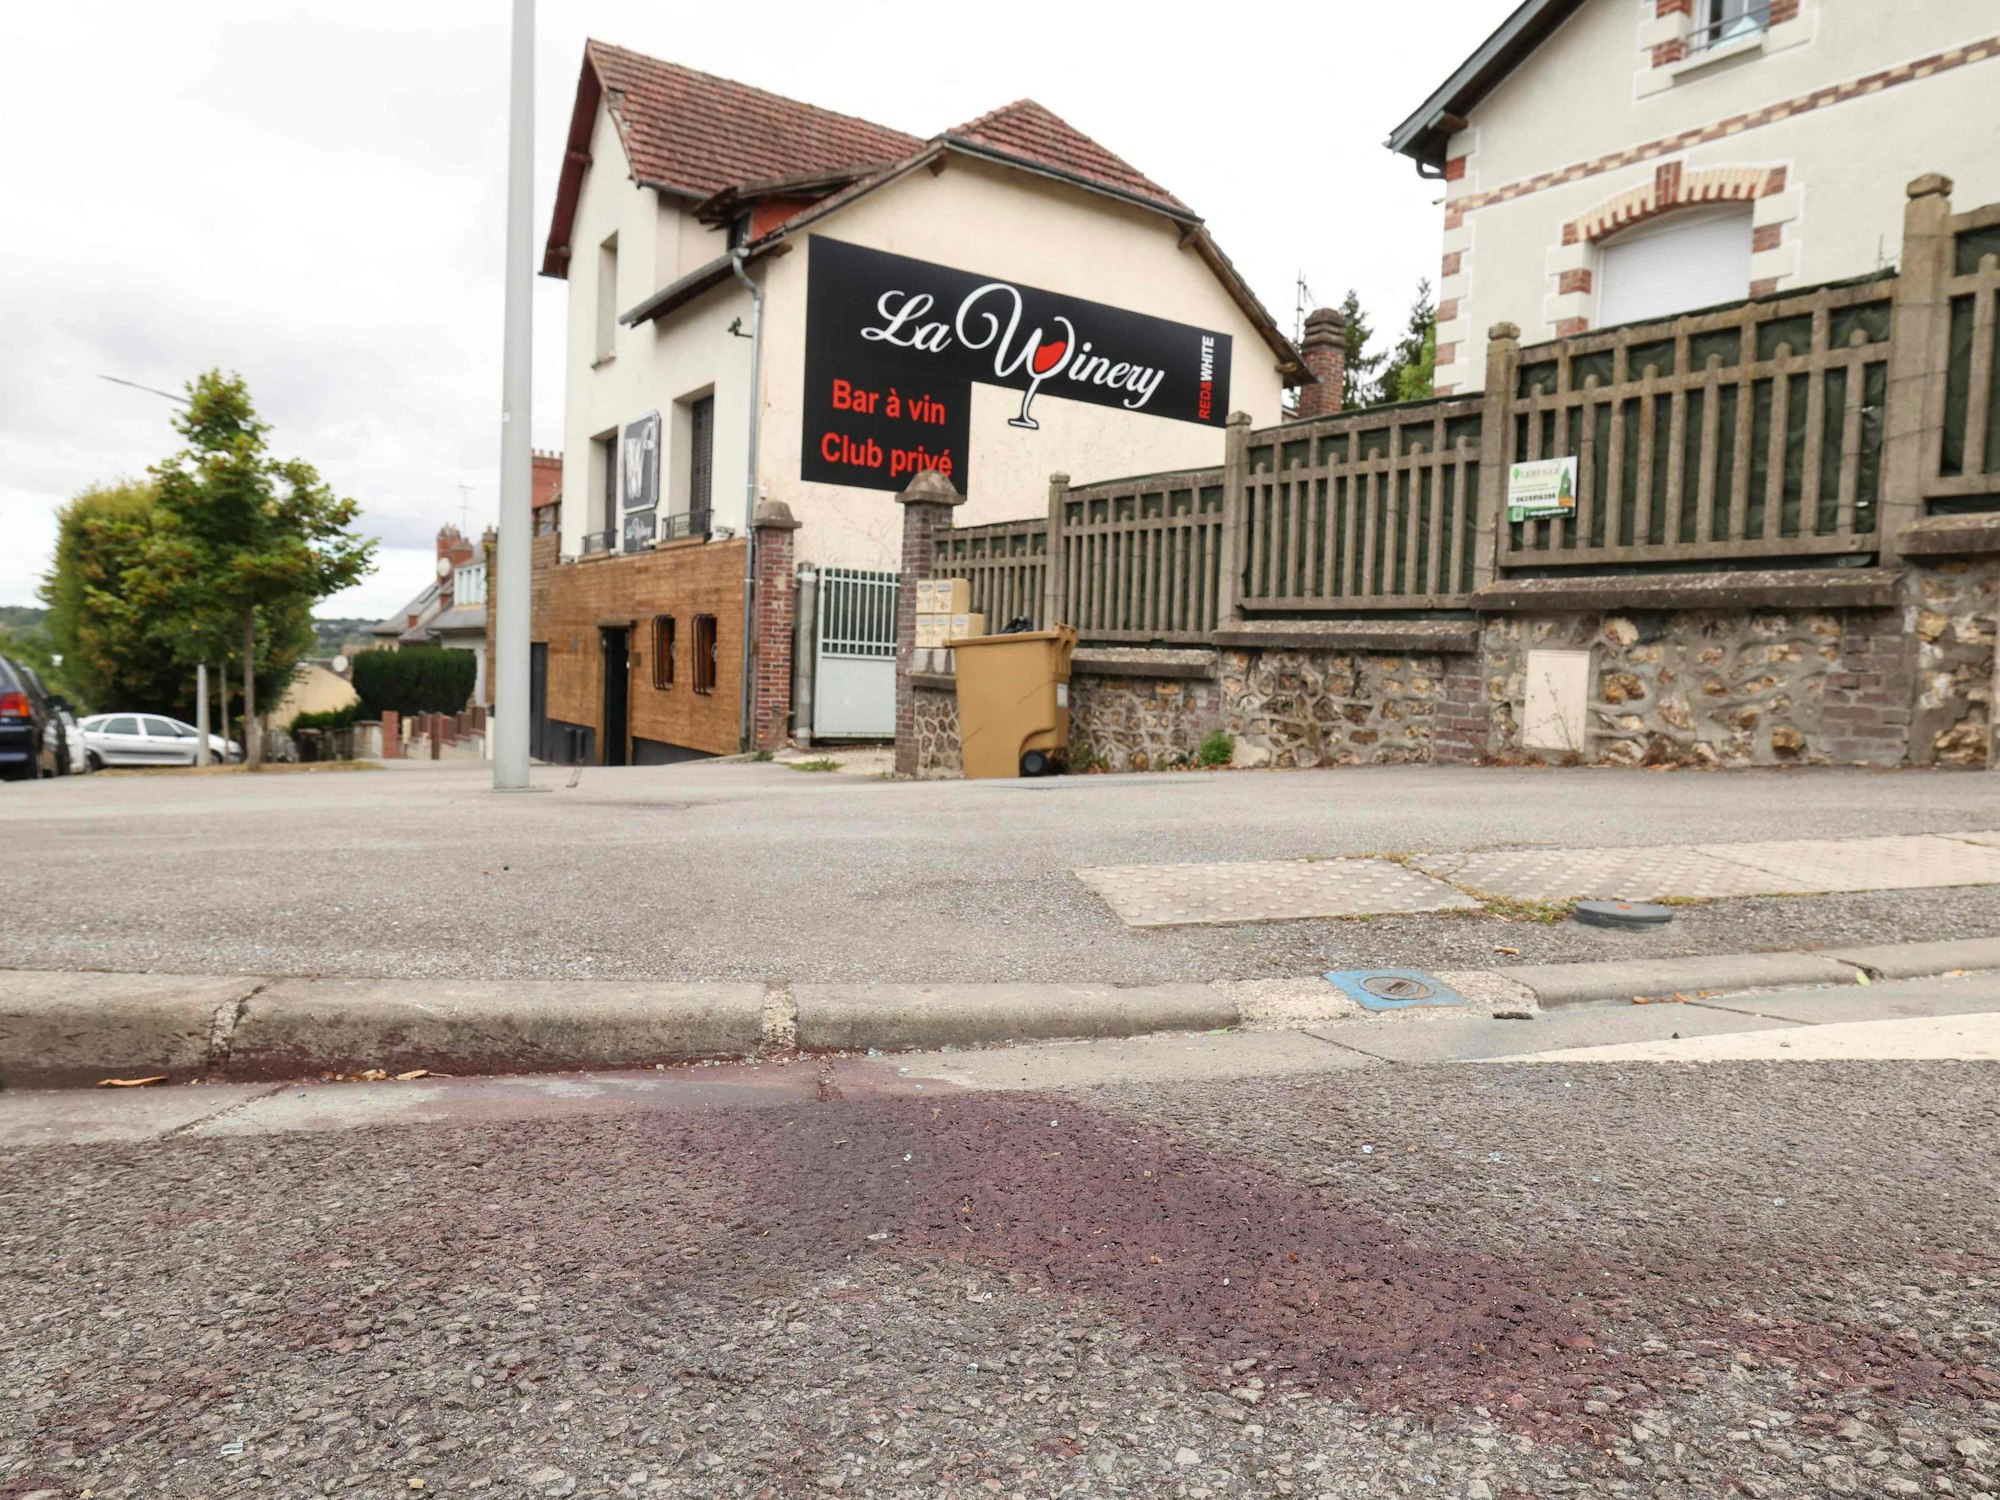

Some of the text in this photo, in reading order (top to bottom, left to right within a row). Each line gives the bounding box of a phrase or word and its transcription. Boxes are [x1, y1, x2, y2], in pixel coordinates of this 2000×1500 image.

[861, 283, 1165, 429] La Winery
[1198, 335, 1214, 420] RED&WHITE
[832, 379, 945, 425] Bar à vin
[821, 432, 953, 478] Club privé
